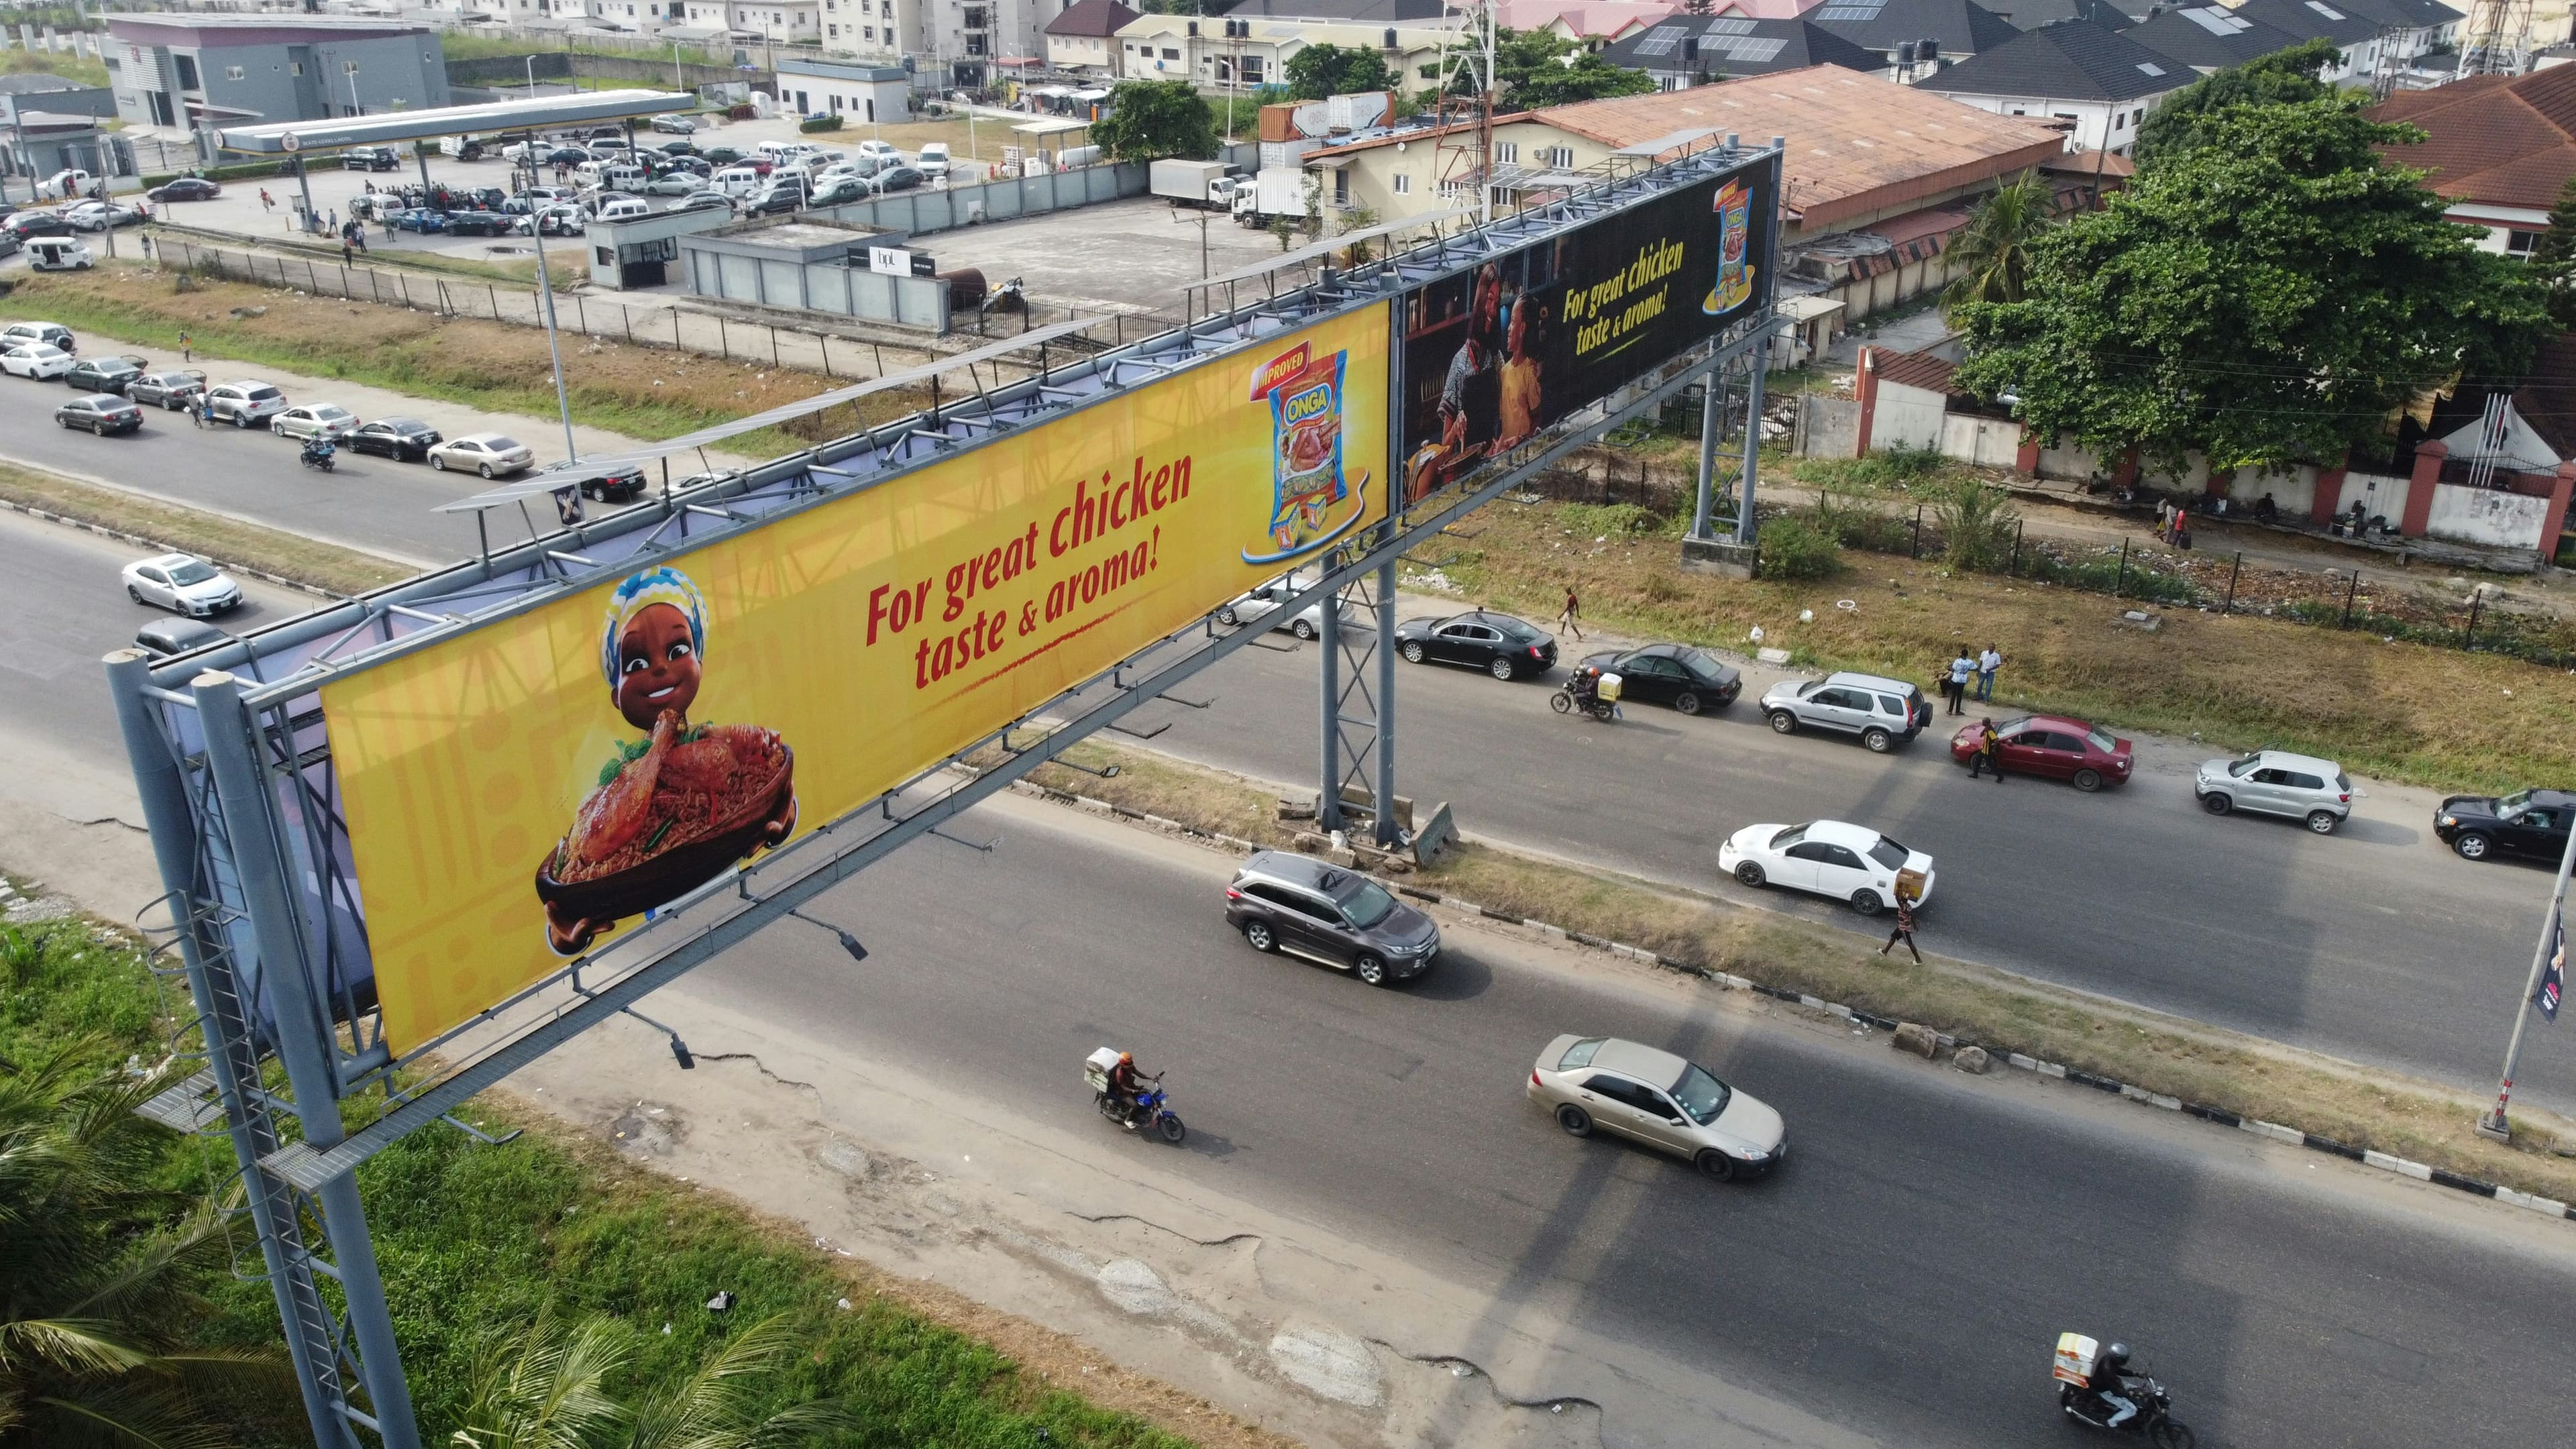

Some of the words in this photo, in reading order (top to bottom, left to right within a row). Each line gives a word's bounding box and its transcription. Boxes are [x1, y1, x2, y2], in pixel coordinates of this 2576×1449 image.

[1727, 210, 1743, 227] ONGA
[1562, 288, 1587, 323] For
[1588, 268, 1625, 319] great
[1627, 237, 1684, 293] chicken
[1576, 316, 1610, 356] taste
[1612, 315, 1621, 337] &
[1622, 281, 1668, 333] aroma!
[1256, 352, 1303, 390] IMPROVED
[1288, 388, 1327, 421] ONGA
[867, 579, 932, 646] For
[943, 523, 1038, 622] great
[1049, 455, 1191, 557] chicken
[915, 610, 1007, 689] taste
[1018, 599, 1037, 637] &
[1046, 525, 1160, 623] aroma!
